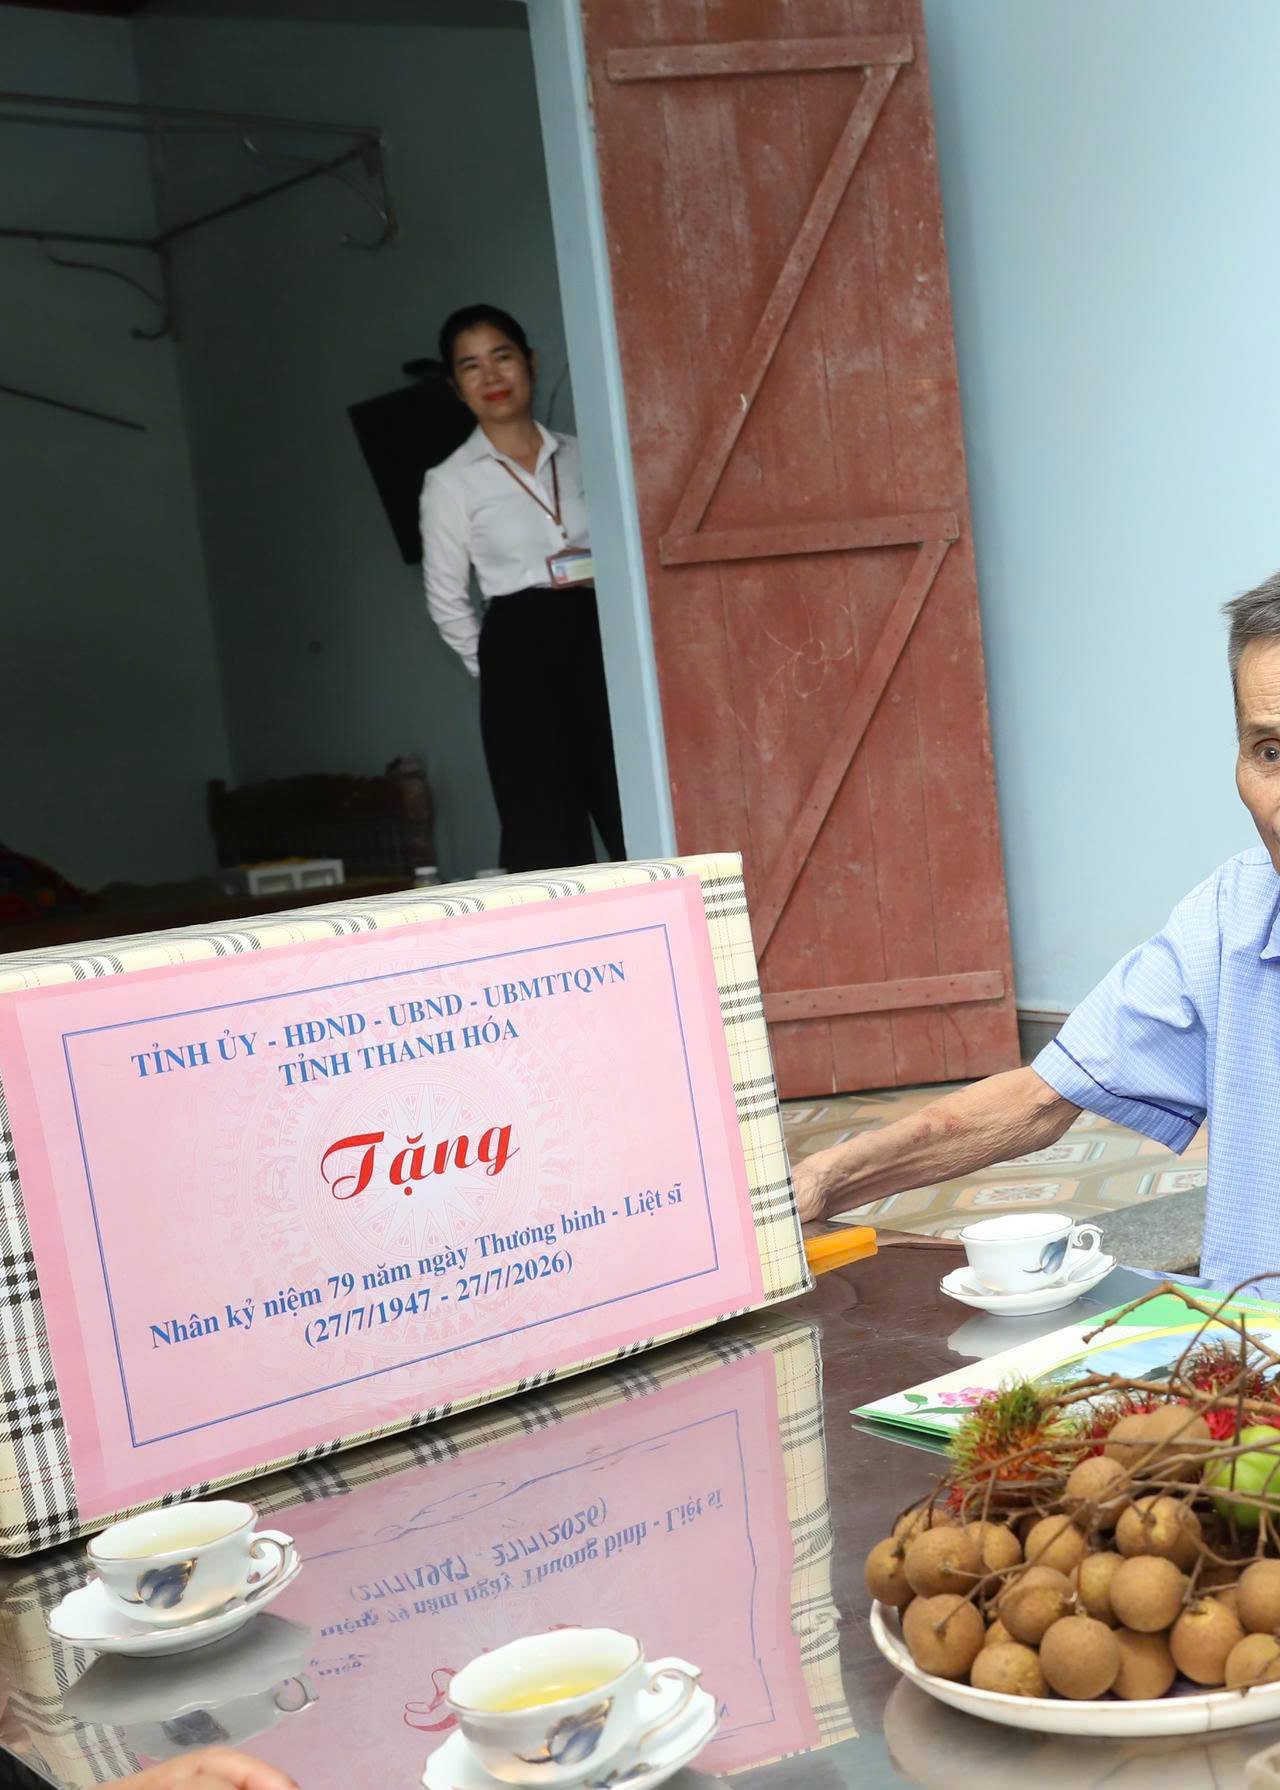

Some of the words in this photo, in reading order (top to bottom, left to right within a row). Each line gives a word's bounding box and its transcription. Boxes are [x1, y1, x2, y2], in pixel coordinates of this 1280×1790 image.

[131, 1042, 210, 1077] TỈNH
[216, 1028, 257, 1060] ỦY
[283, 1012, 366, 1048] HĐND
[388, 994, 463, 1027] UBND
[482, 961, 626, 1008] UBMTTQVN
[278, 1053, 352, 1086] TỈNH
[357, 1030, 455, 1071] THANH
[462, 1015, 519, 1049] HÓA
[320, 1124, 520, 1200] Tặng
[149, 1314, 220, 1349] Nhân
[225, 1298, 256, 1330] kỷ
[263, 1288, 322, 1317] niệm
[327, 1272, 355, 1299] 79
[362, 1262, 411, 1291] năm
[418, 1245, 469, 1277] ngày
[474, 1223, 557, 1257] Thương
[560, 1206, 606, 1235] binh
[624, 1190, 663, 1217] Liệt
[668, 1183, 682, 1205] sĩ
[304, 1289, 431, 1348] (27/7/1947
[456, 1249, 573, 1302] 27/7/2026)
